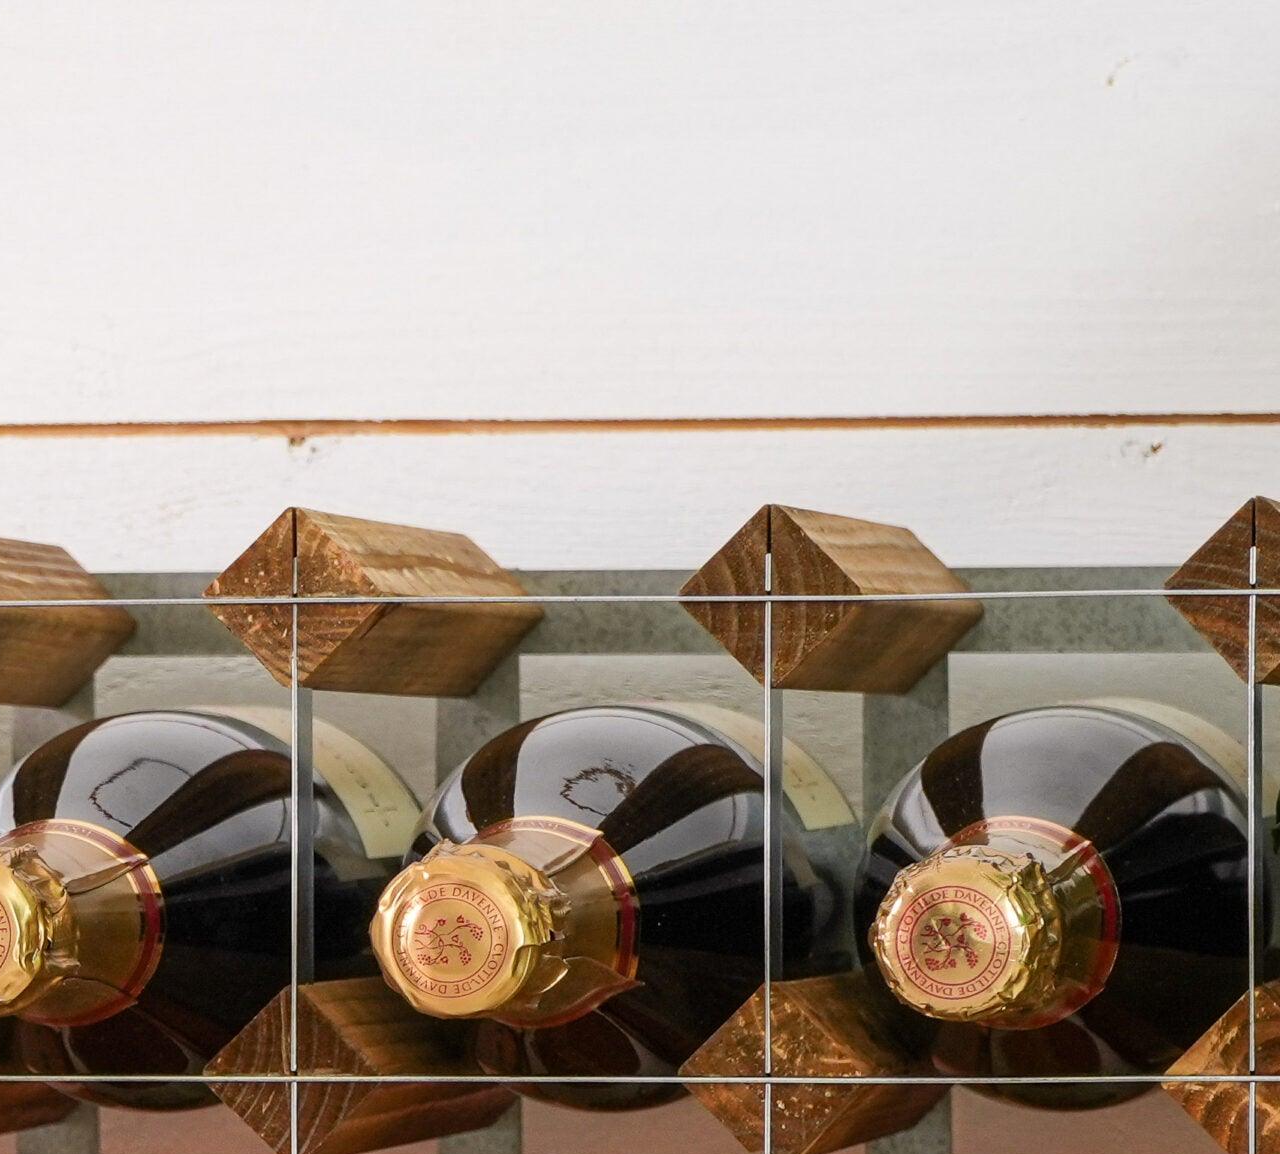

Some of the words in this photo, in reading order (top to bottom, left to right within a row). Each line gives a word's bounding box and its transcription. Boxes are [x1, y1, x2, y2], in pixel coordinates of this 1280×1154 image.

[452, 887, 503, 932] DAVENNE
[899, 889, 950, 944] CLOTILDE
[954, 889, 1005, 935] DAVENNE
[454, 944, 504, 994] CLOTILDE
[902, 954, 952, 996] DAVENNE
[959, 941, 1007, 995] CLOTILDE
